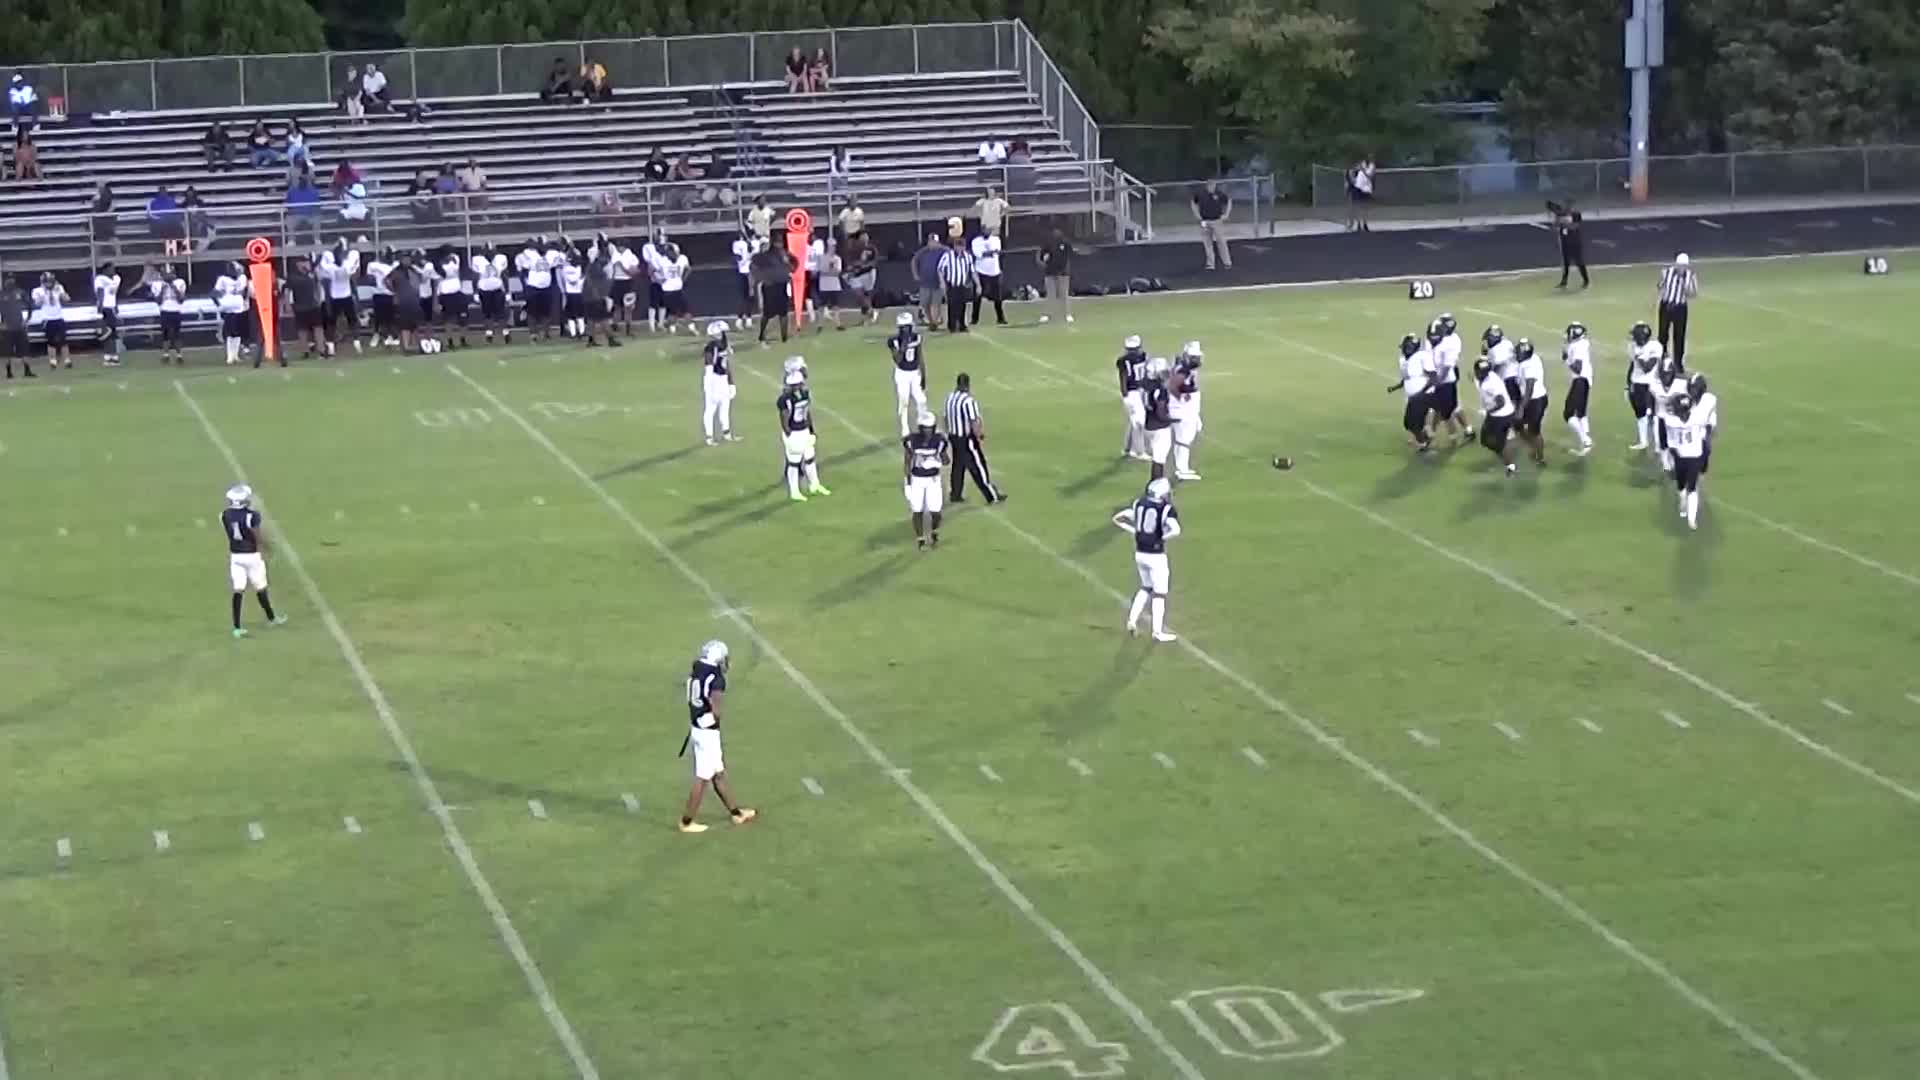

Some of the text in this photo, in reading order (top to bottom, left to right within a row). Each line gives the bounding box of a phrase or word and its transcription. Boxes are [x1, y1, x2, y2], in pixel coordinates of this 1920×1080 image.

[1867, 257, 1888, 273] 10
[1413, 281, 1433, 298] 20
[1136, 504, 1158, 534] 10
